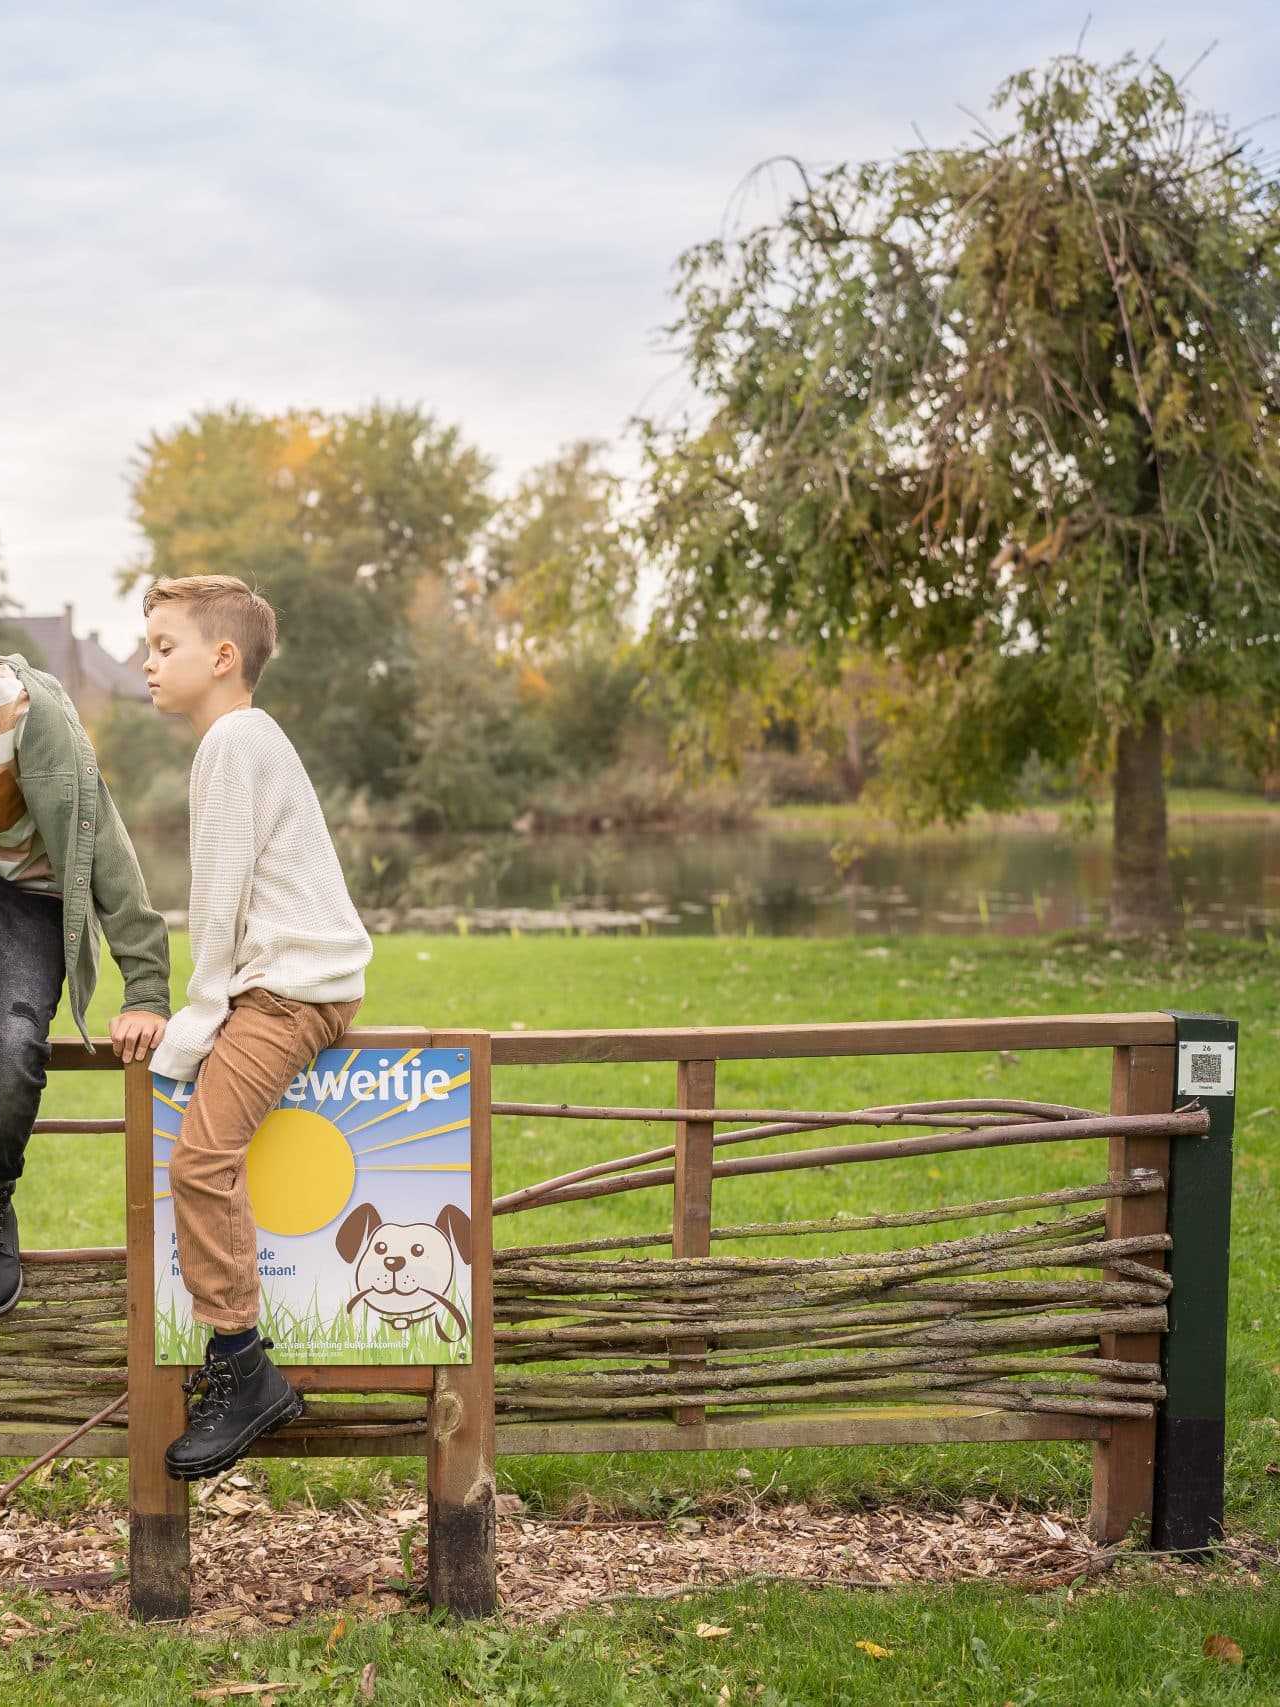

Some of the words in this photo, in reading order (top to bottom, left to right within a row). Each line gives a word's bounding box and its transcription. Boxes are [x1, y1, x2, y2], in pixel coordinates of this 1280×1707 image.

[258, 1264, 296, 1276] staan!
[290, 1342, 305, 1350] van
[307, 1341, 343, 1351] Stichting
